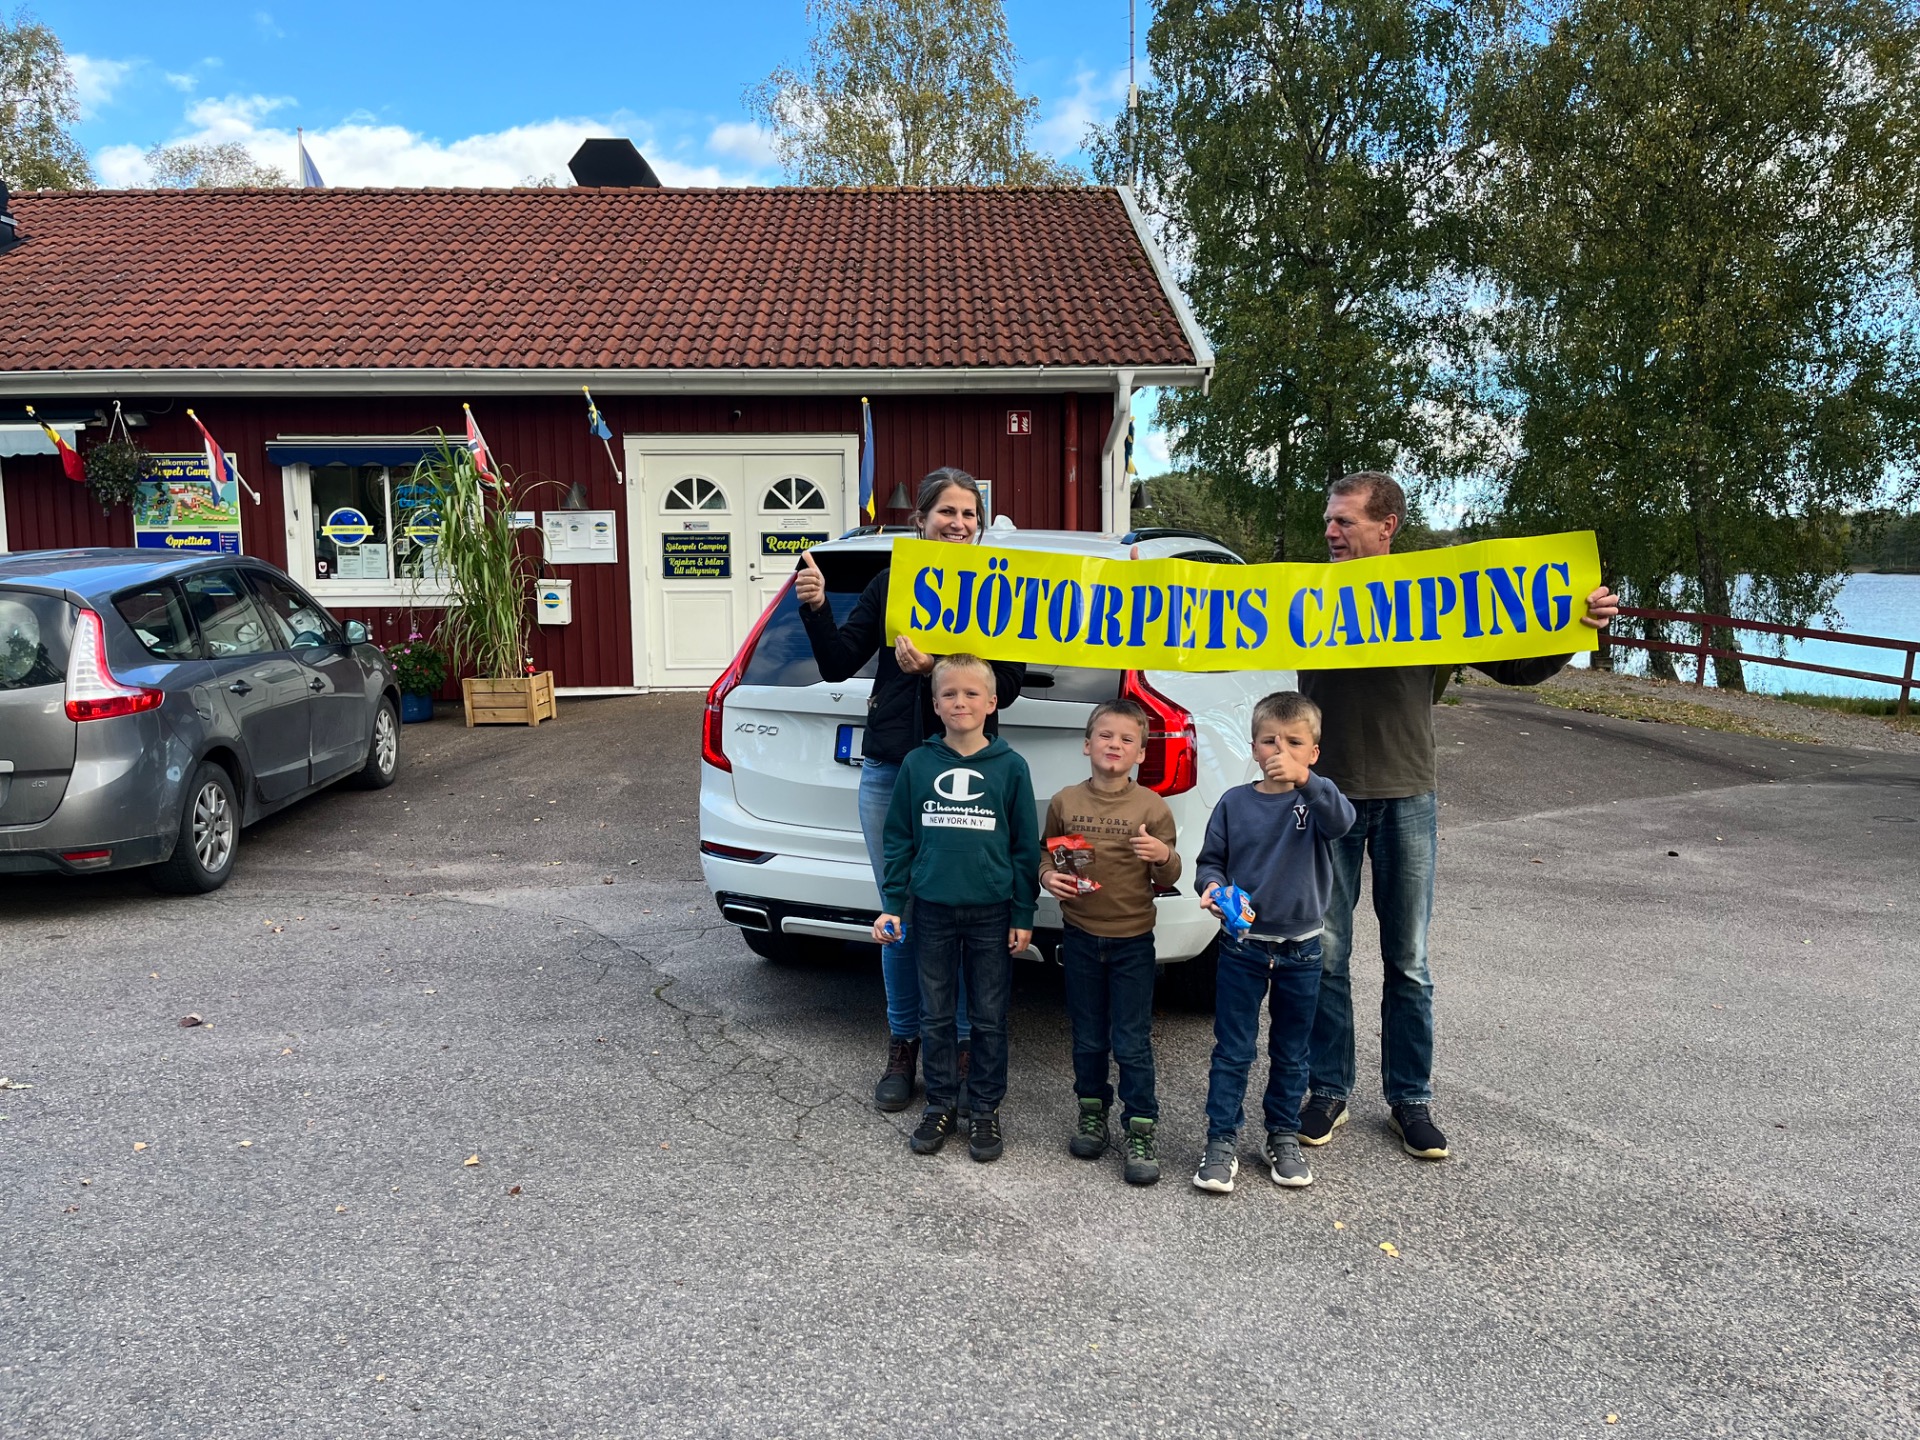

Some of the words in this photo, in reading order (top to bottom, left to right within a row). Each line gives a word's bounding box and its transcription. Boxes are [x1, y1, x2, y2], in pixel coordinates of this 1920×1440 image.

[165, 534, 212, 548] Öppettider
[698, 542, 728, 552] Camping
[669, 558, 696, 567] Kajaker
[697, 558, 703, 566] &
[674, 566, 685, 575] till
[910, 556, 1268, 650] SJÖTORPETS
[1288, 561, 1573, 649] CAMPING
[923, 800, 995, 816] Champion
[929, 816, 945, 824] NEW
[946, 816, 968, 825] YORK
[1071, 815, 1094, 823] NEW
[1292, 804, 1309, 830] Y
[1071, 824, 1102, 833] STREET
[1104, 827, 1133, 836] STYLE
